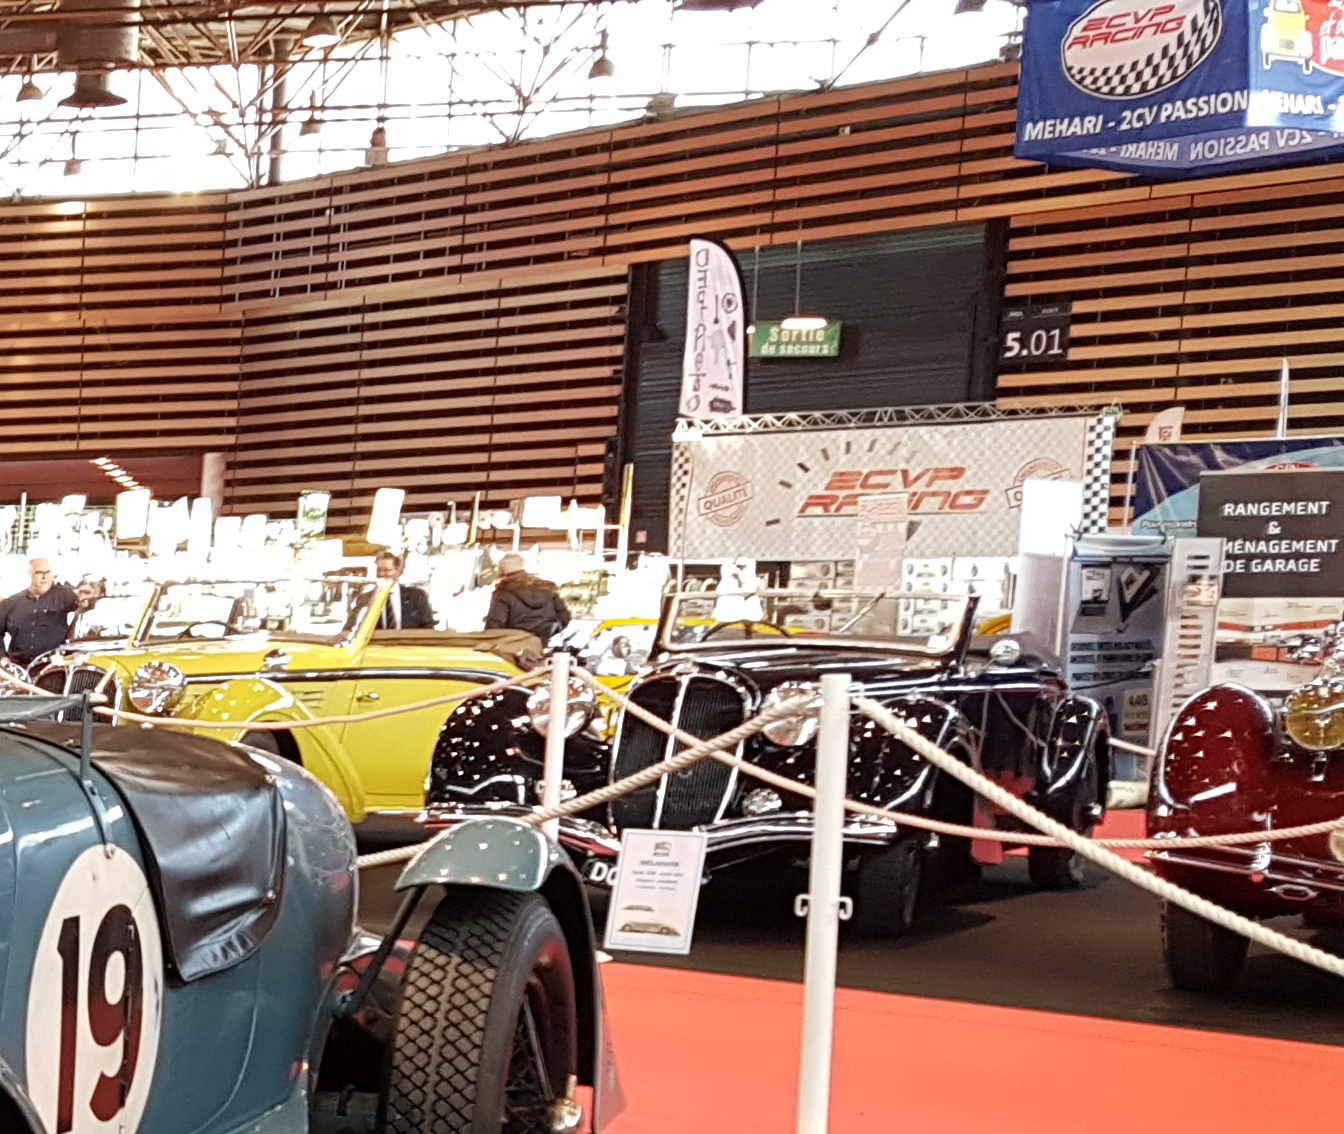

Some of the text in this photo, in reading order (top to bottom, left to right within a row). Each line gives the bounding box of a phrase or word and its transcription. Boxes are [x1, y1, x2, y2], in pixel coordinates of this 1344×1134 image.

[1067, 16, 1187, 50] RACING
[1024, 115, 1103, 141] MEHARI
[1118, 105, 1158, 131] 2CV
[1162, 90, 1249, 123] PASSION
[1003, 328, 1063, 358] 5.01
[1223, 501, 1330, 516] RANGEMENT
[1266, 521, 1282, 534] &
[1223, 539, 1339, 553] MÉNAGEMENT
[1222, 559, 1321, 573] DE GARAGE
